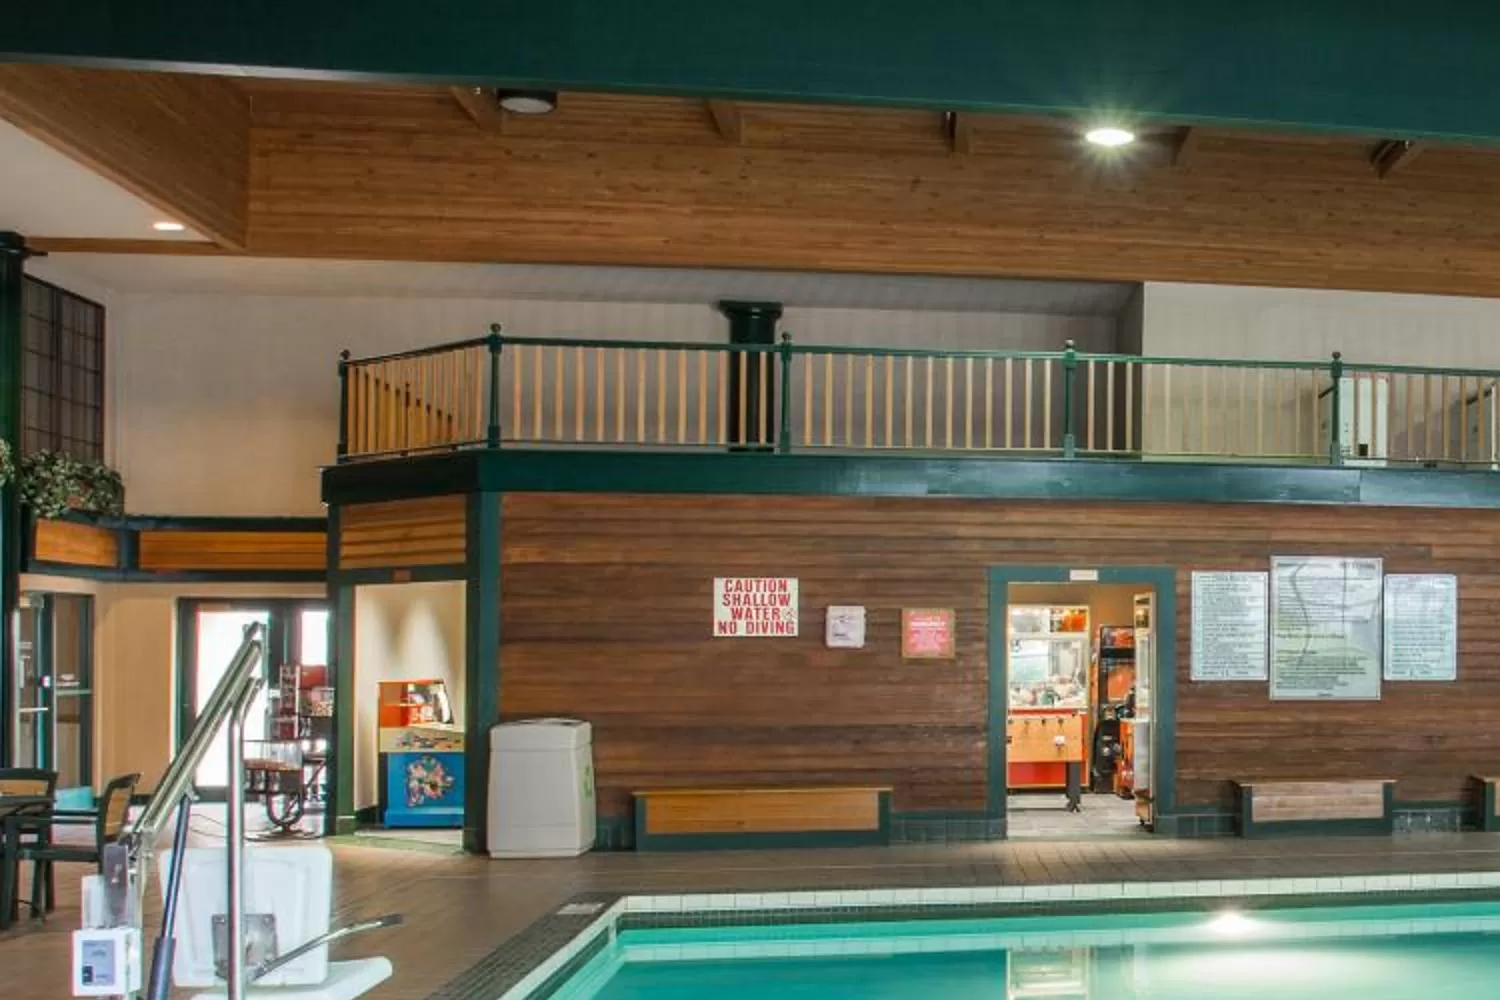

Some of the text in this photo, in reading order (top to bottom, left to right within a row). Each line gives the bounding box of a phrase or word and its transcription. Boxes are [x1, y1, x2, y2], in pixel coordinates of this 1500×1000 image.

[724, 579, 788, 593] CAUTION
[722, 593, 791, 607] SHALLOW
[731, 607, 782, 621] WATER
[717, 621, 795, 635] NO DIVING
